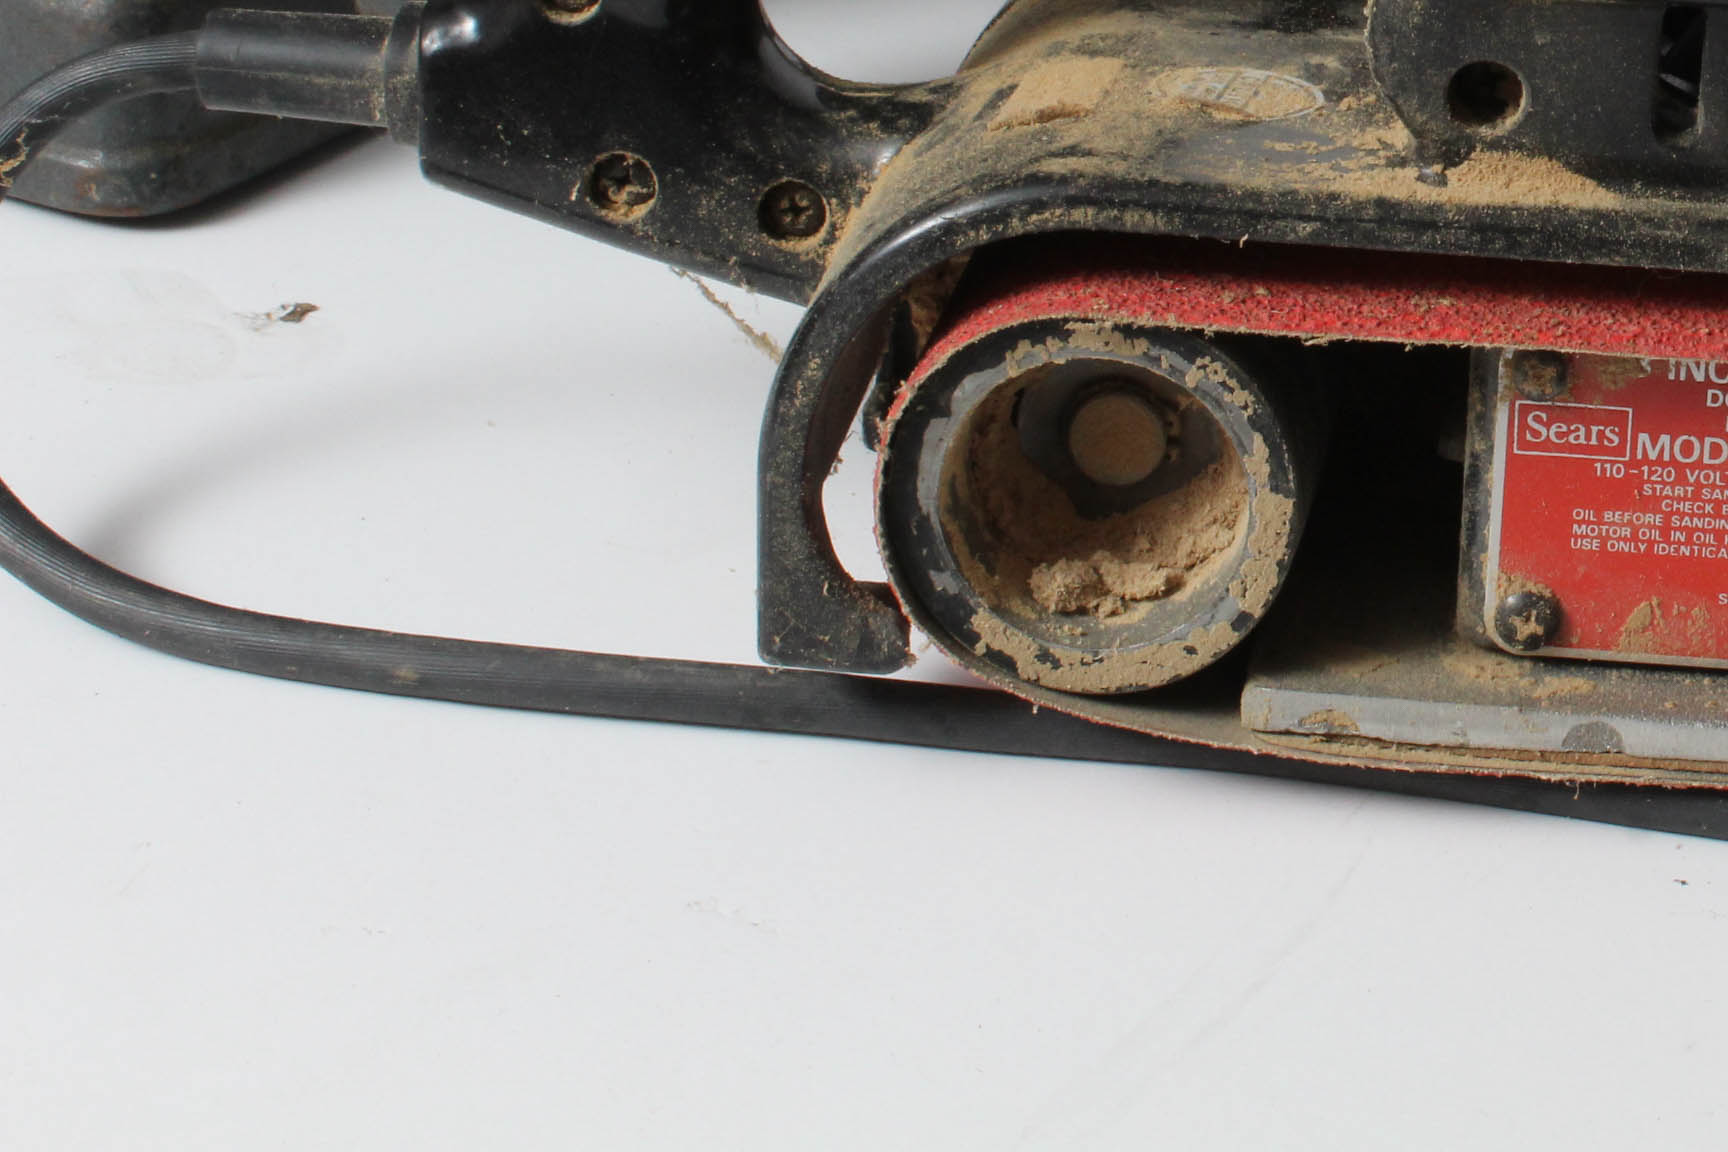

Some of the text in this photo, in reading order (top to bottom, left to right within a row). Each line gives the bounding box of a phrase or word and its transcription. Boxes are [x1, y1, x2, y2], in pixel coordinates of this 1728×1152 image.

[1524, 410, 1620, 448] Sears
[1642, 484, 1694, 499] START
[1661, 499, 1715, 515] CHECK
[1572, 508, 1597, 522] OIL
[1603, 511, 1664, 527] BEFORE
[1572, 523, 1631, 540] MOTOR
[1638, 528, 1663, 541] OIL
[1670, 529, 1686, 543] IN
[1692, 531, 1718, 545] OIL
[1570, 537, 1601, 551] USE
[1606, 540, 1647, 554] ONLY
